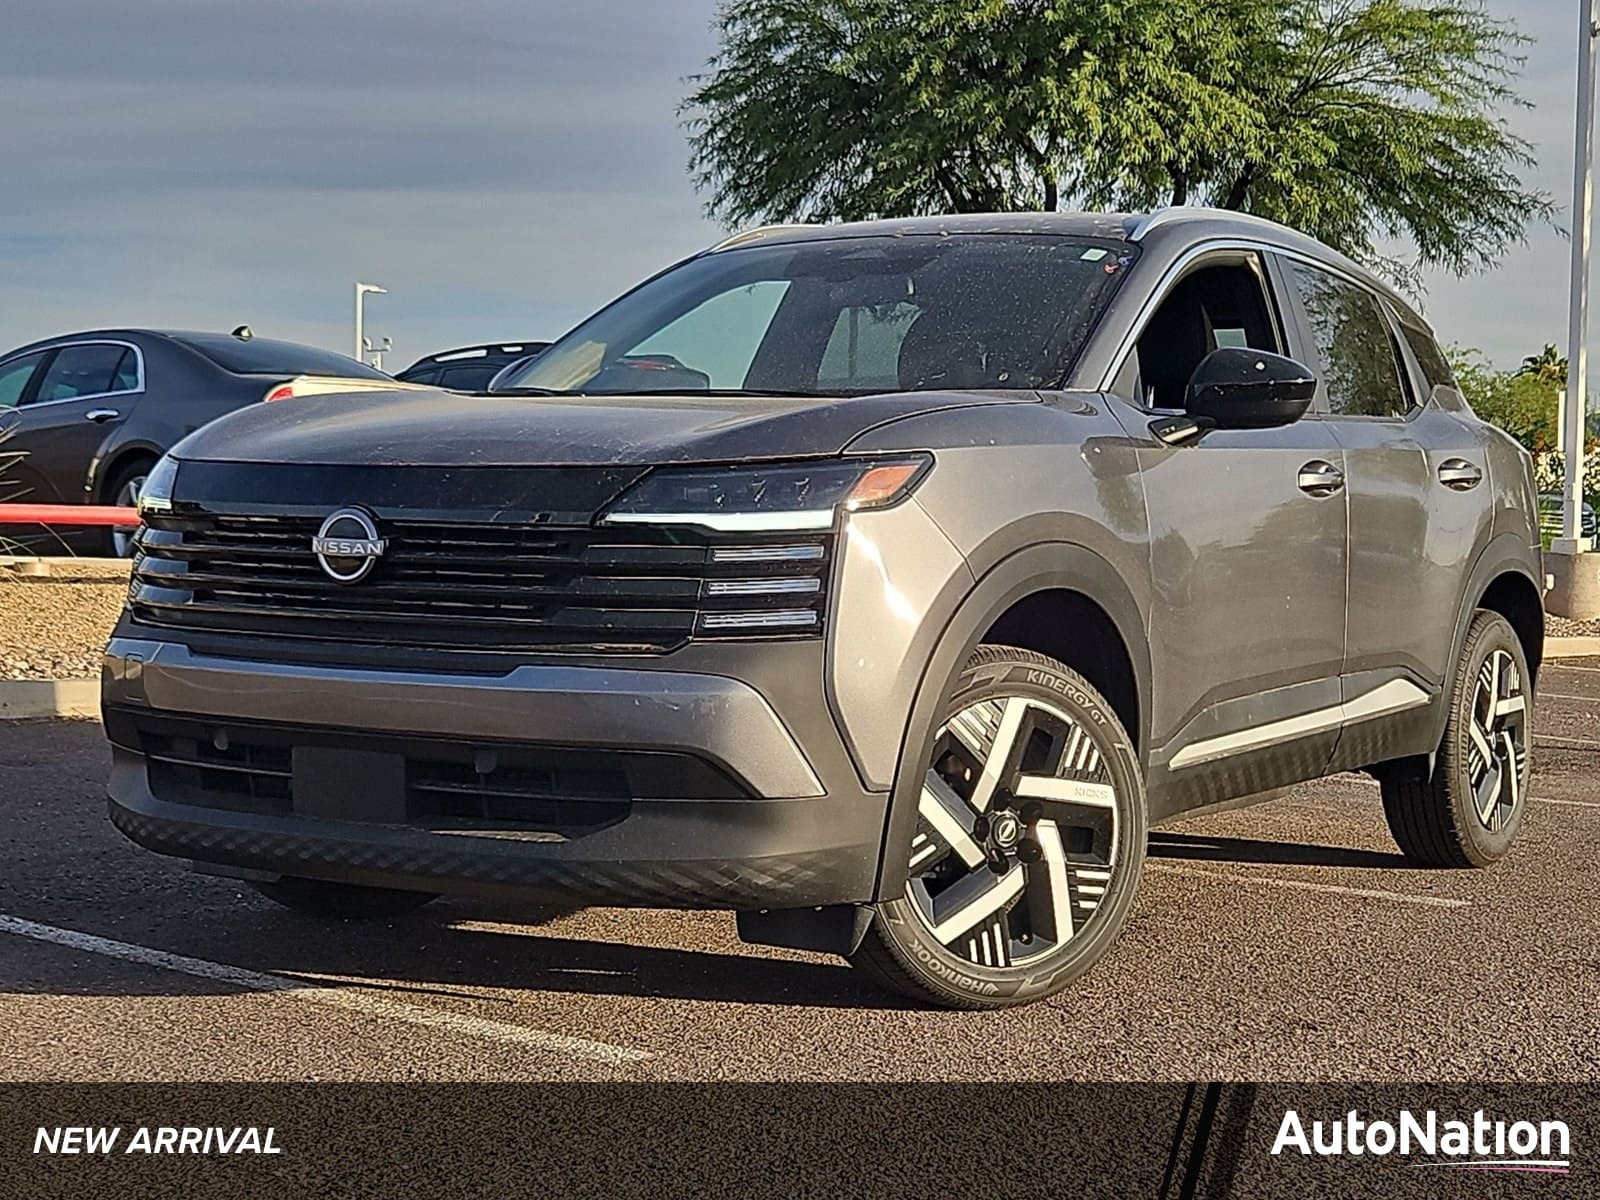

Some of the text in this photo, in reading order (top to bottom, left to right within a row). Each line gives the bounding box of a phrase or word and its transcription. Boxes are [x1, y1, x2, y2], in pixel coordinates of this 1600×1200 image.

[313, 539, 381, 555] NISSAN
[1027, 669, 1107, 726] KINERGY GT
[1073, 786, 1109, 800] KICKS
